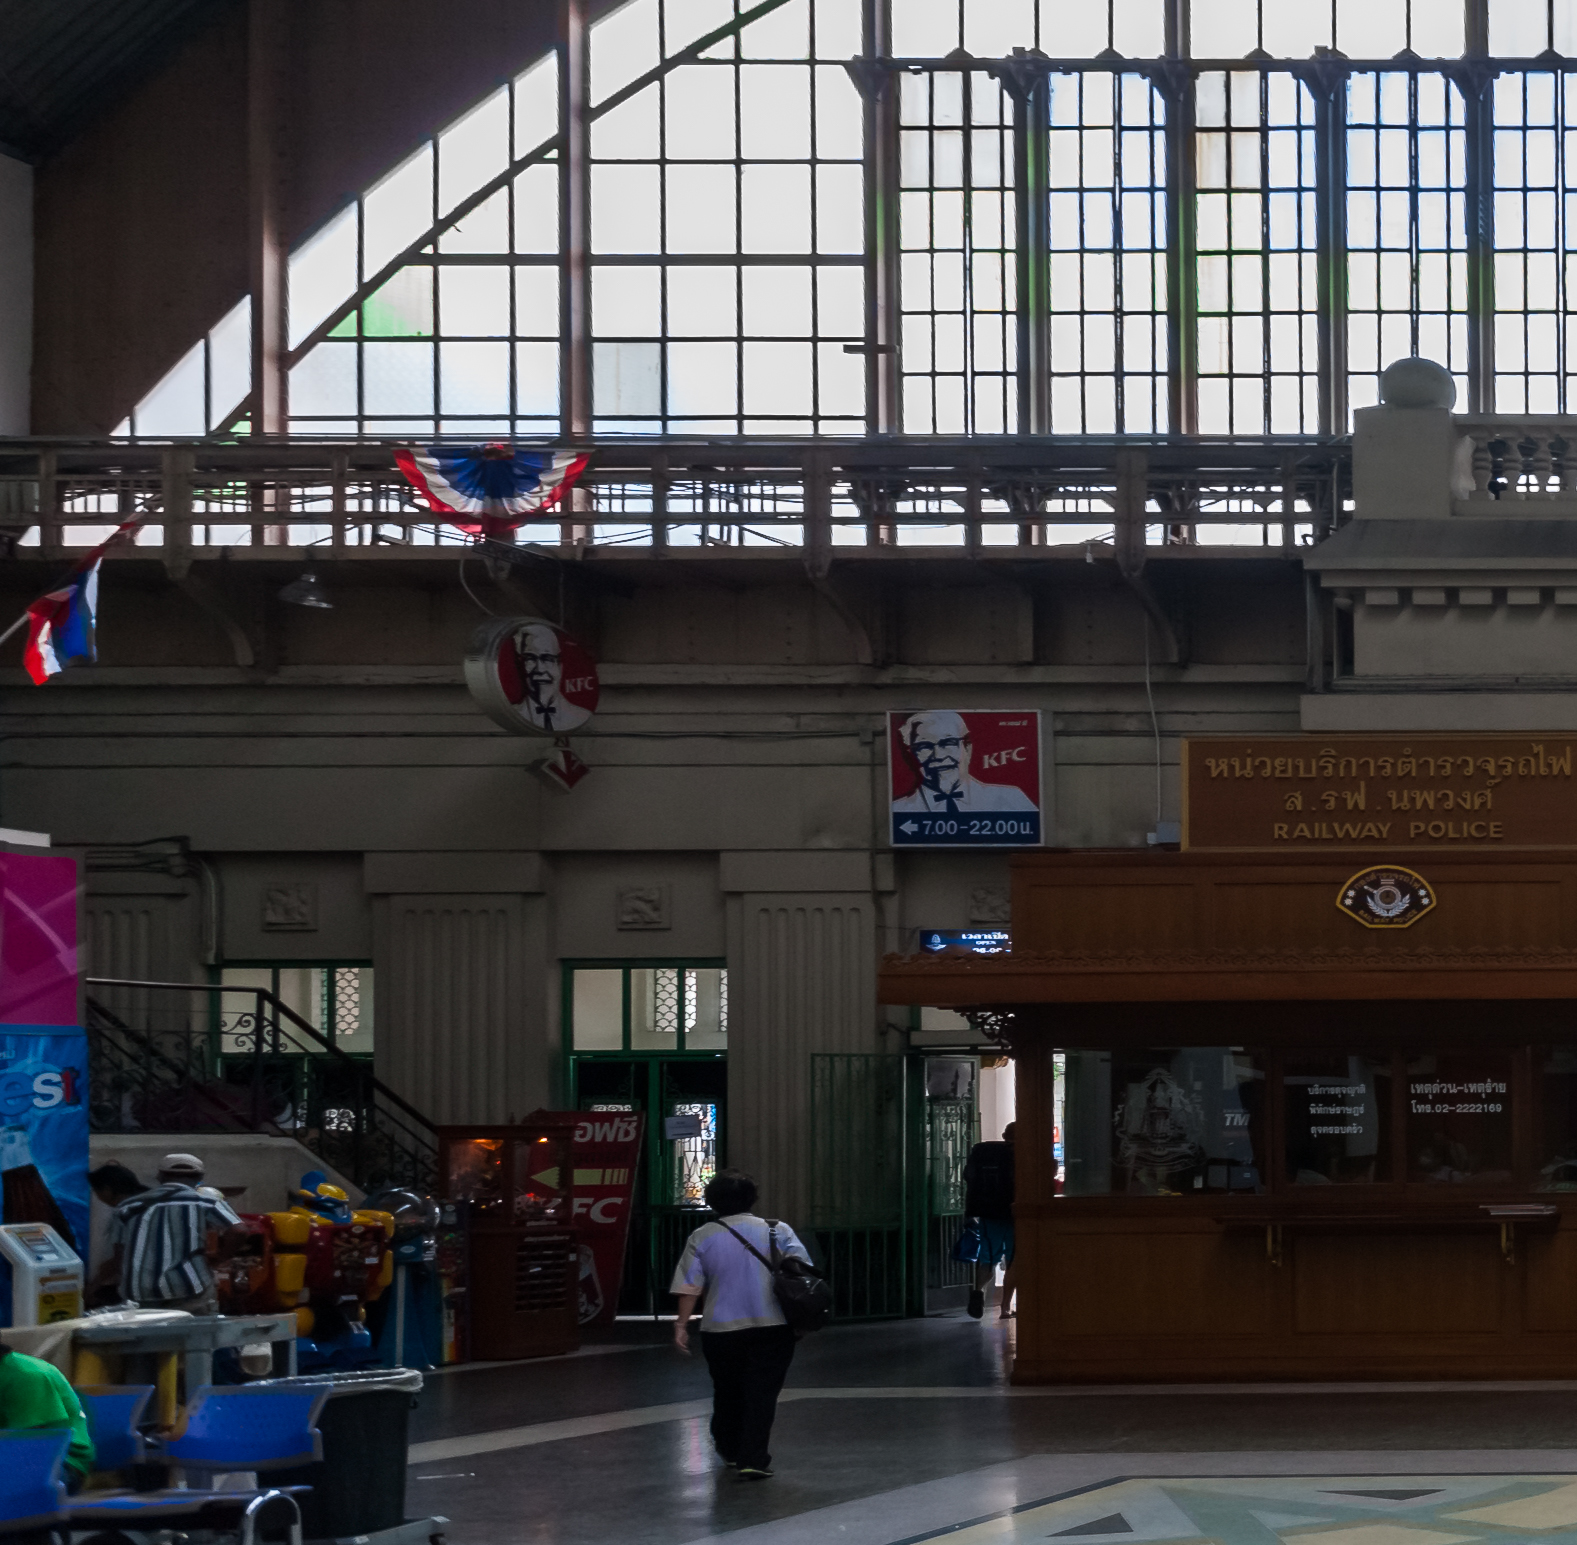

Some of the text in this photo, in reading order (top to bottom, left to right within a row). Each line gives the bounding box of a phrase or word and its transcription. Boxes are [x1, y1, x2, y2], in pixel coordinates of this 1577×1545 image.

[565, 676, 594, 693] KFC
[982, 746, 1027, 769] KFC
[1205, 743, 1573, 779] หน่วยบริการตำรวจรถไฟ
[1273, 821, 1504, 839] RAILWAY POLICE
